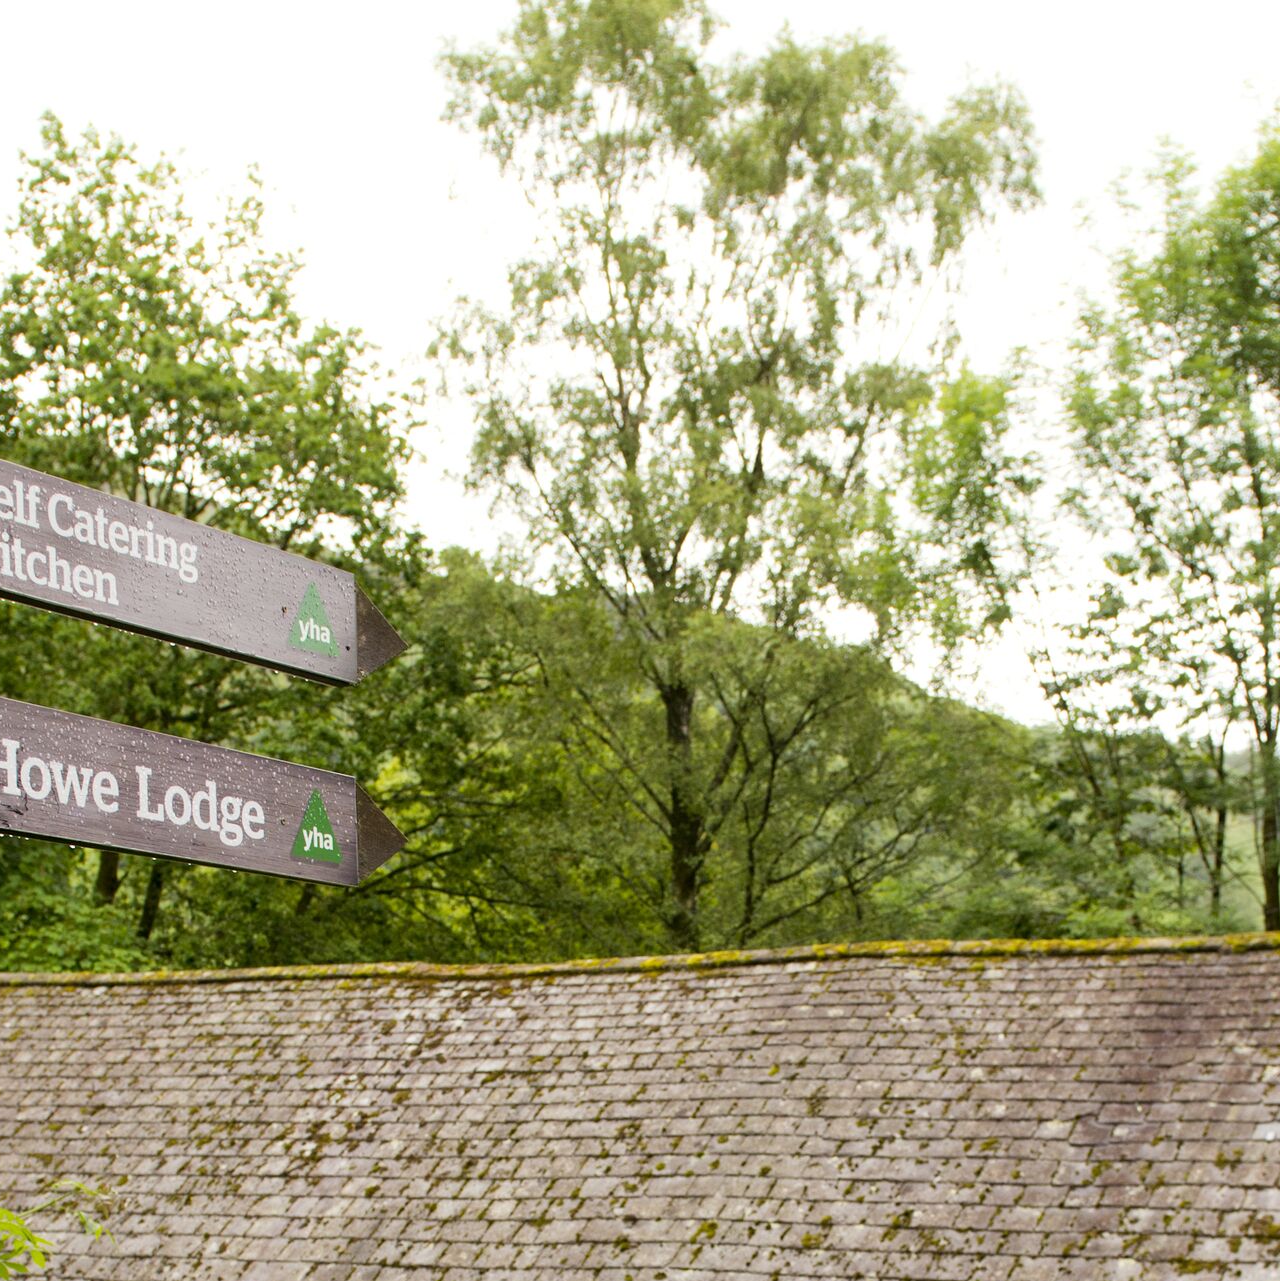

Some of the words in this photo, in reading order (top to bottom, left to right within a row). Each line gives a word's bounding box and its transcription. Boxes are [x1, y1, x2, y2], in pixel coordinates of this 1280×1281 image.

[48, 493, 198, 582] Catering
[298, 616, 330, 644] yha
[135, 765, 264, 845] Lodge
[303, 827, 333, 850] yha
